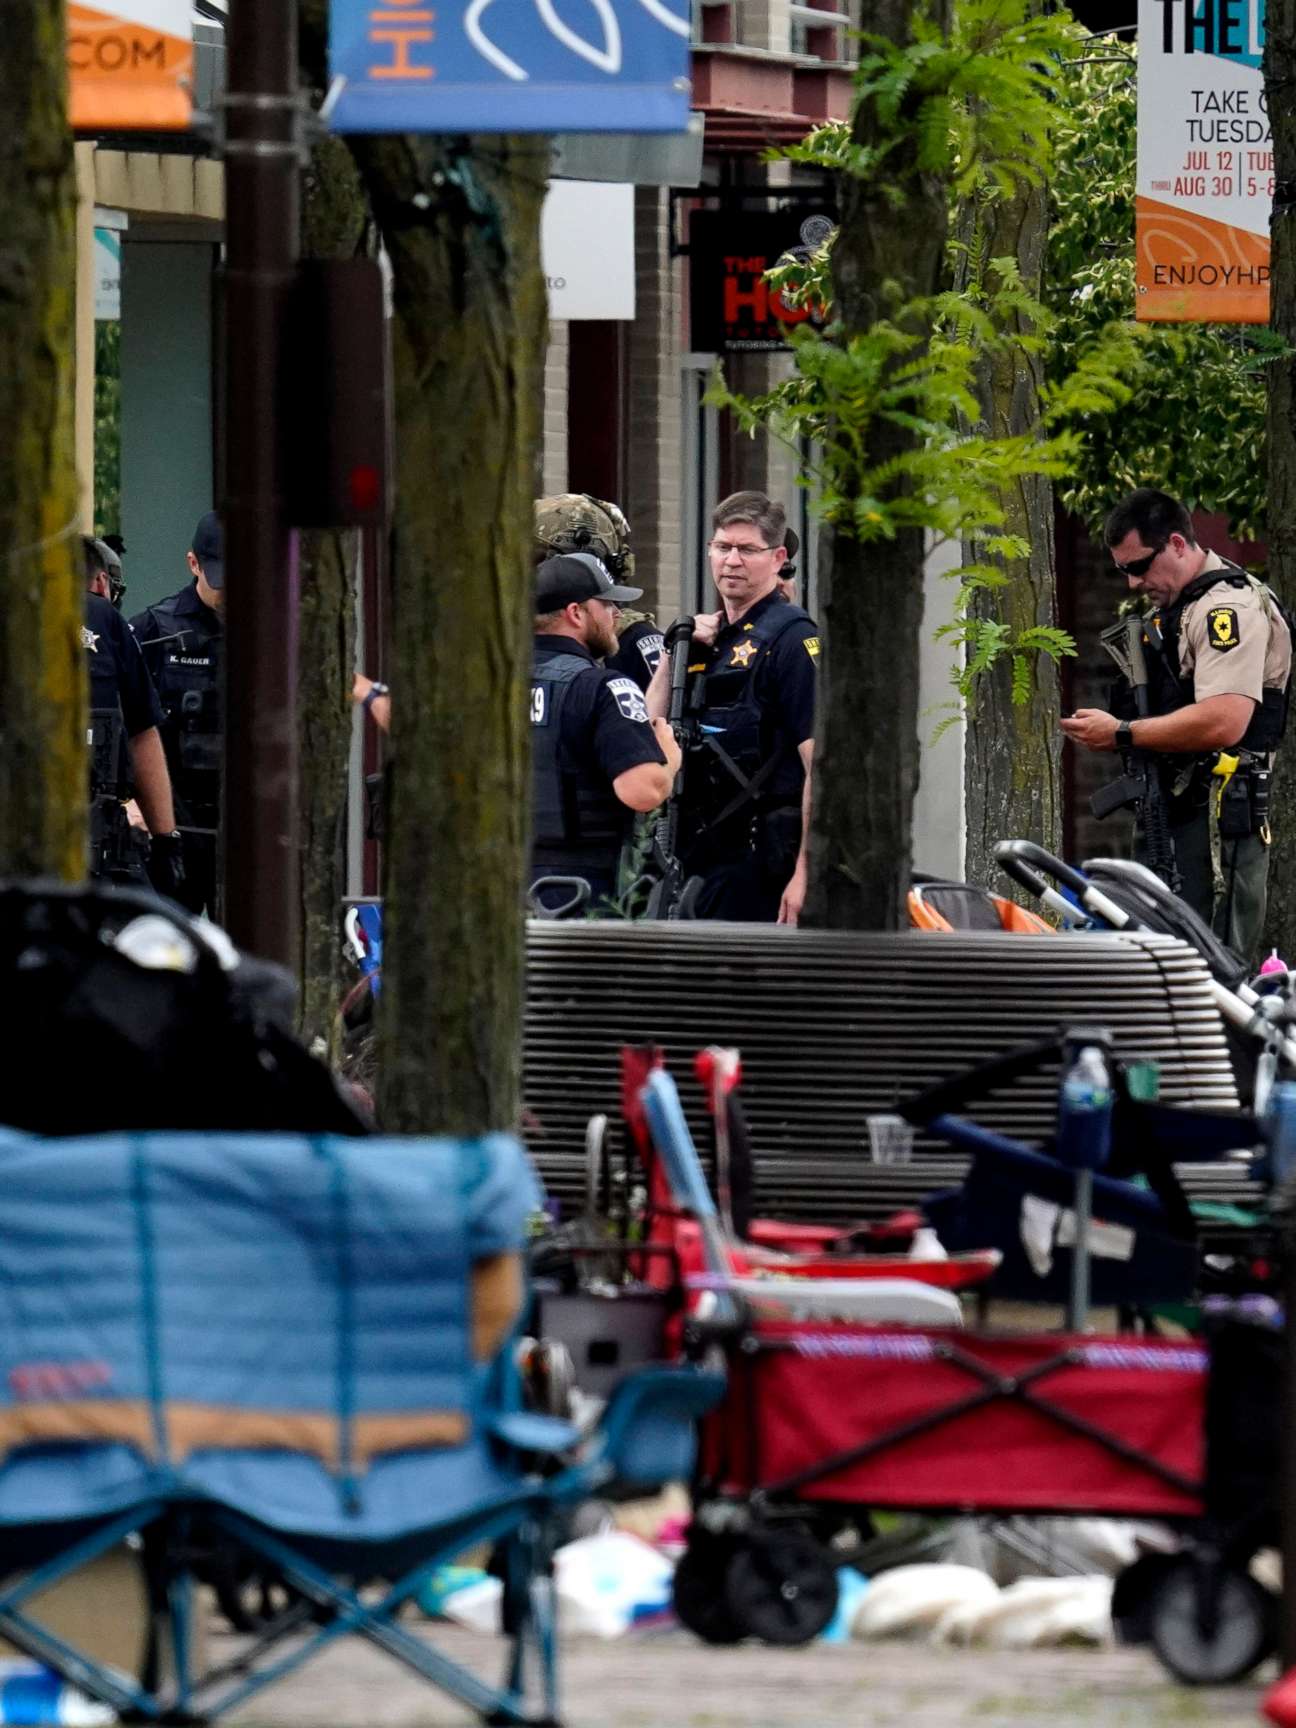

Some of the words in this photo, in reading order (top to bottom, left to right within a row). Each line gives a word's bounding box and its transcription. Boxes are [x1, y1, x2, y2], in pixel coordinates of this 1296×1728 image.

[1191, 90, 1249, 114] TAKE
[1183, 152, 1210, 171] JUL
[1216, 152, 1233, 171] 12
[1174, 176, 1205, 196] AUG
[1211, 176, 1233, 196] 30
[723, 256, 766, 273] THE
[1154, 264, 1271, 286] ENJOYHP
